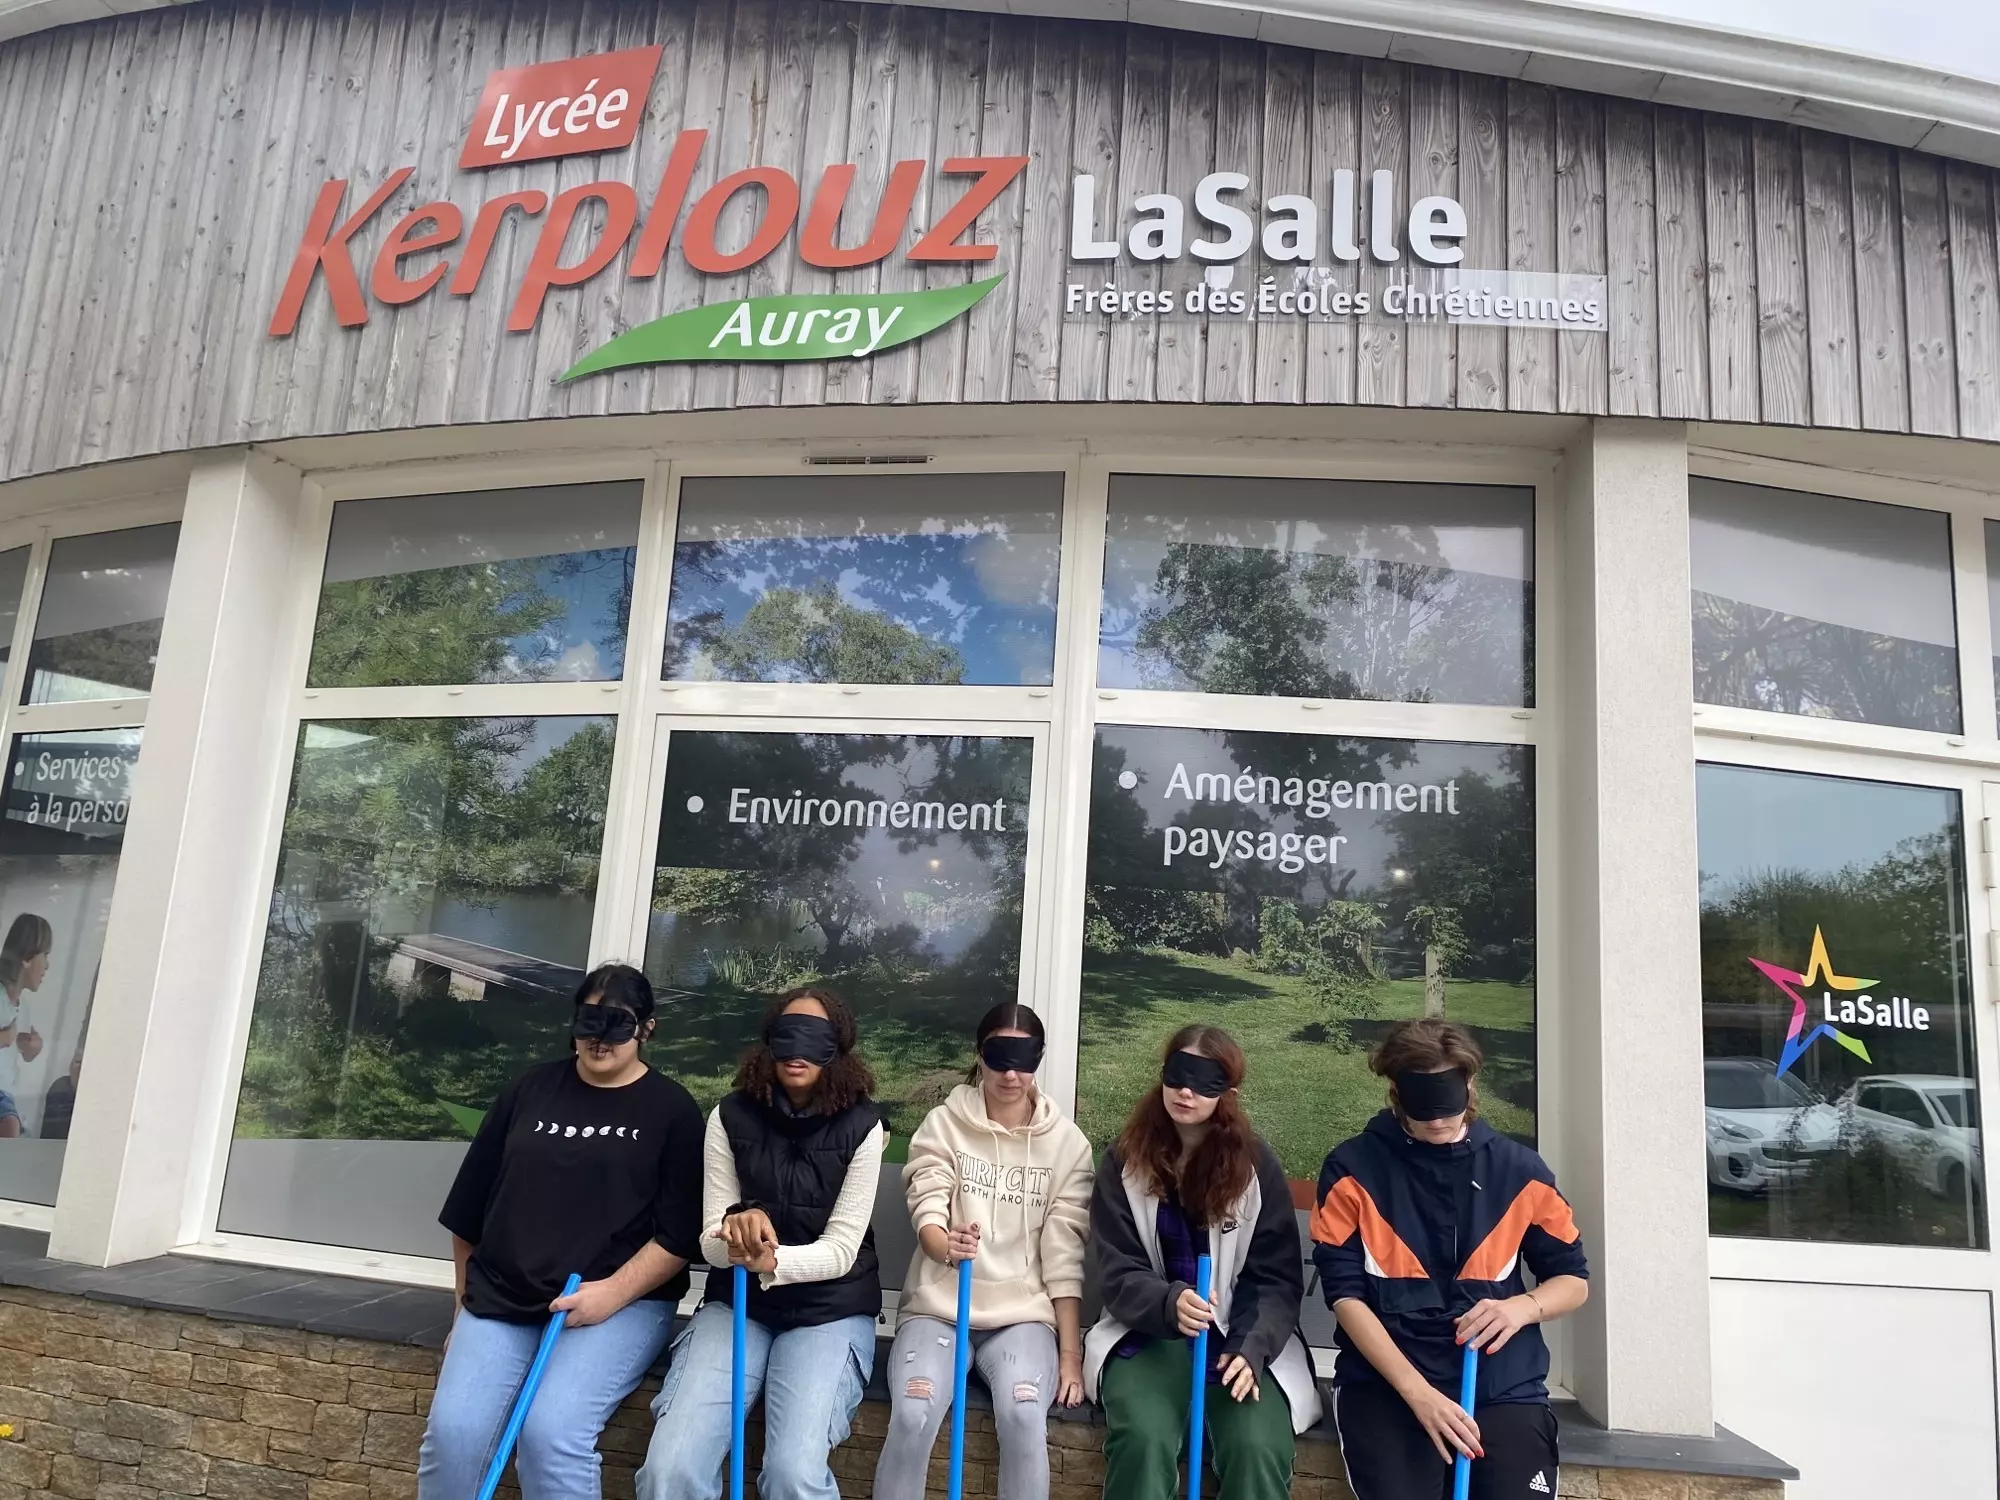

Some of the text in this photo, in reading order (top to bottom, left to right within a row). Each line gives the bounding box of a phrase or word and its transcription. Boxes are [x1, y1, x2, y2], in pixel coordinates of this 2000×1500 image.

[482, 78, 629, 159] Lycée
[269, 129, 1030, 336] Kerplouz
[1071, 169, 1468, 263] LaSalle
[1066, 276, 1600, 323] Frères des Écoles Chrétiennes
[708, 302, 904, 358] Auray
[36, 751, 122, 781] Services
[27, 795, 40, 824] à
[44, 793, 63, 824] la
[728, 788, 1007, 832] Environnement
[1164, 763, 1460, 818] Aménagement
[1164, 826, 1347, 873] paysager
[1824, 991, 1930, 1030] LaSalle
[962, 1184, 989, 1199] ORTH
